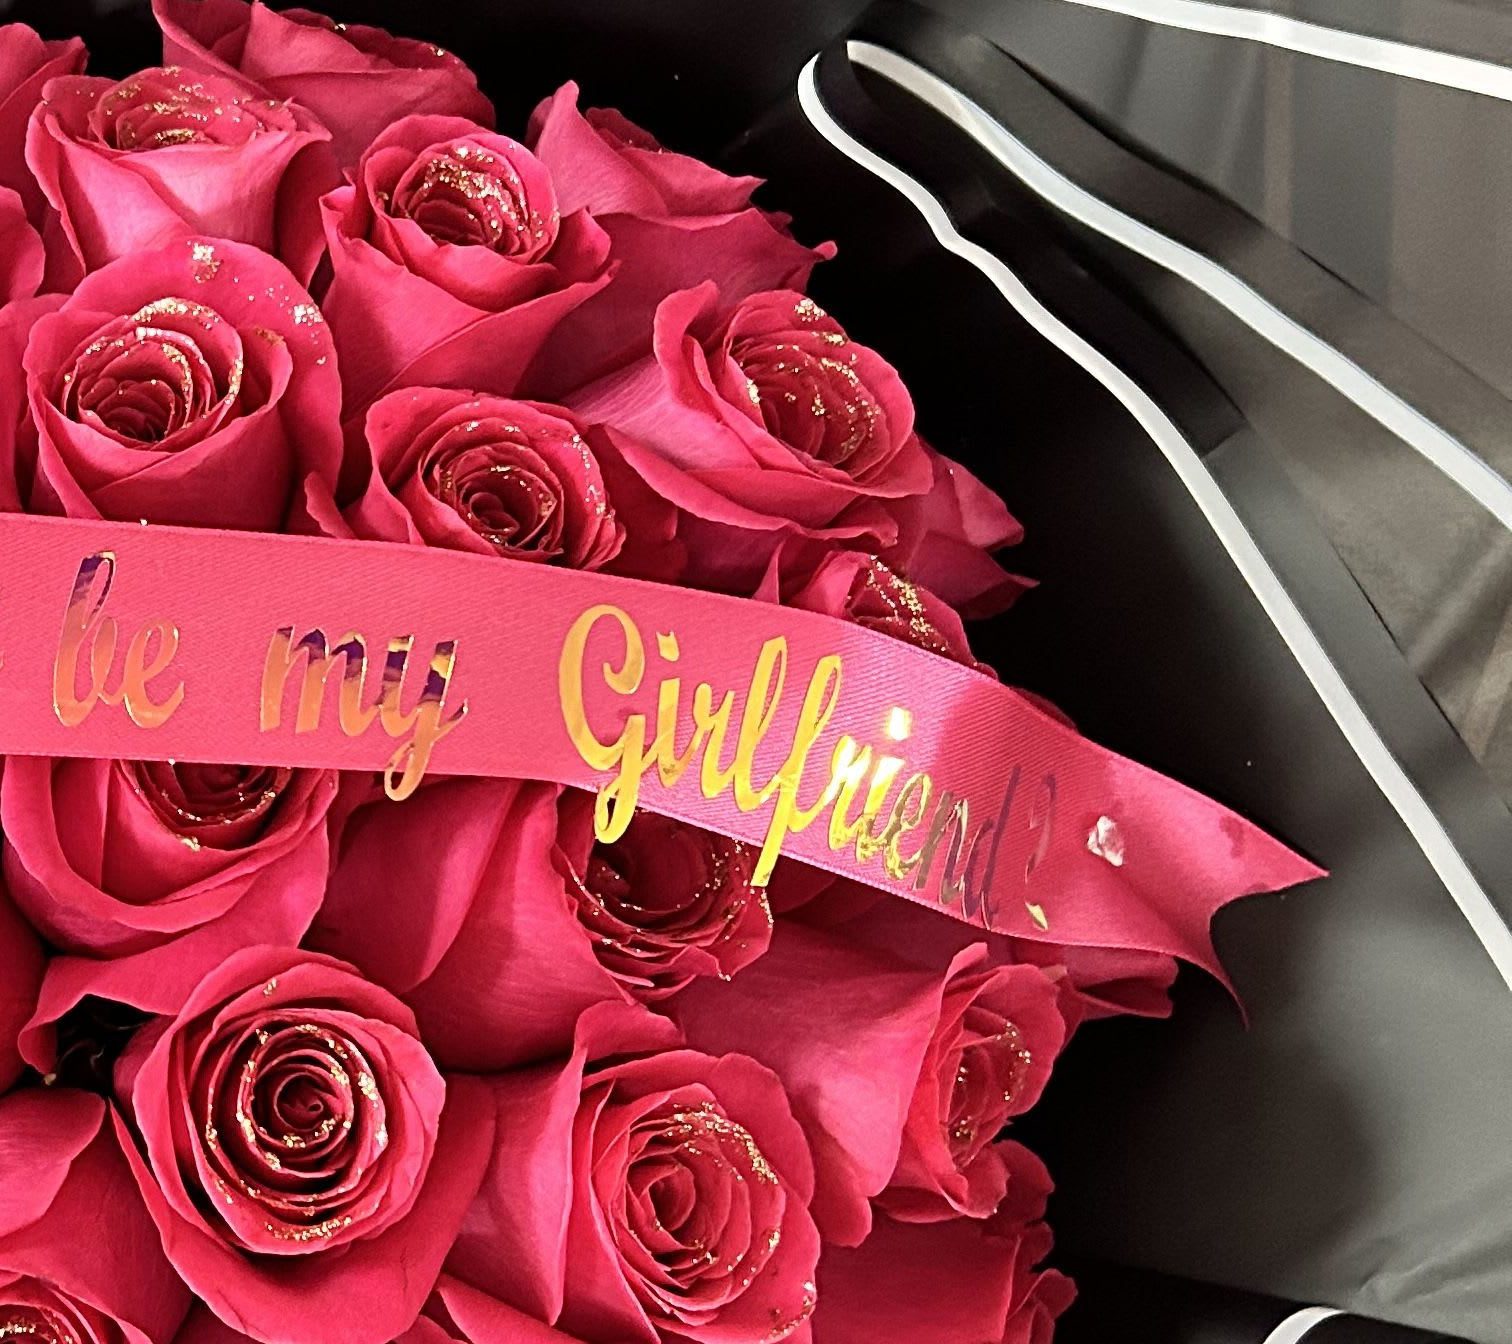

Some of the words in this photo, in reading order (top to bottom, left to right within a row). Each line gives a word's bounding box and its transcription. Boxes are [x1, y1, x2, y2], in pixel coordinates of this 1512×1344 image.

[52, 551, 185, 729] be
[260, 625, 469, 803] my
[558, 603, 1058, 932] Girlfriend?
